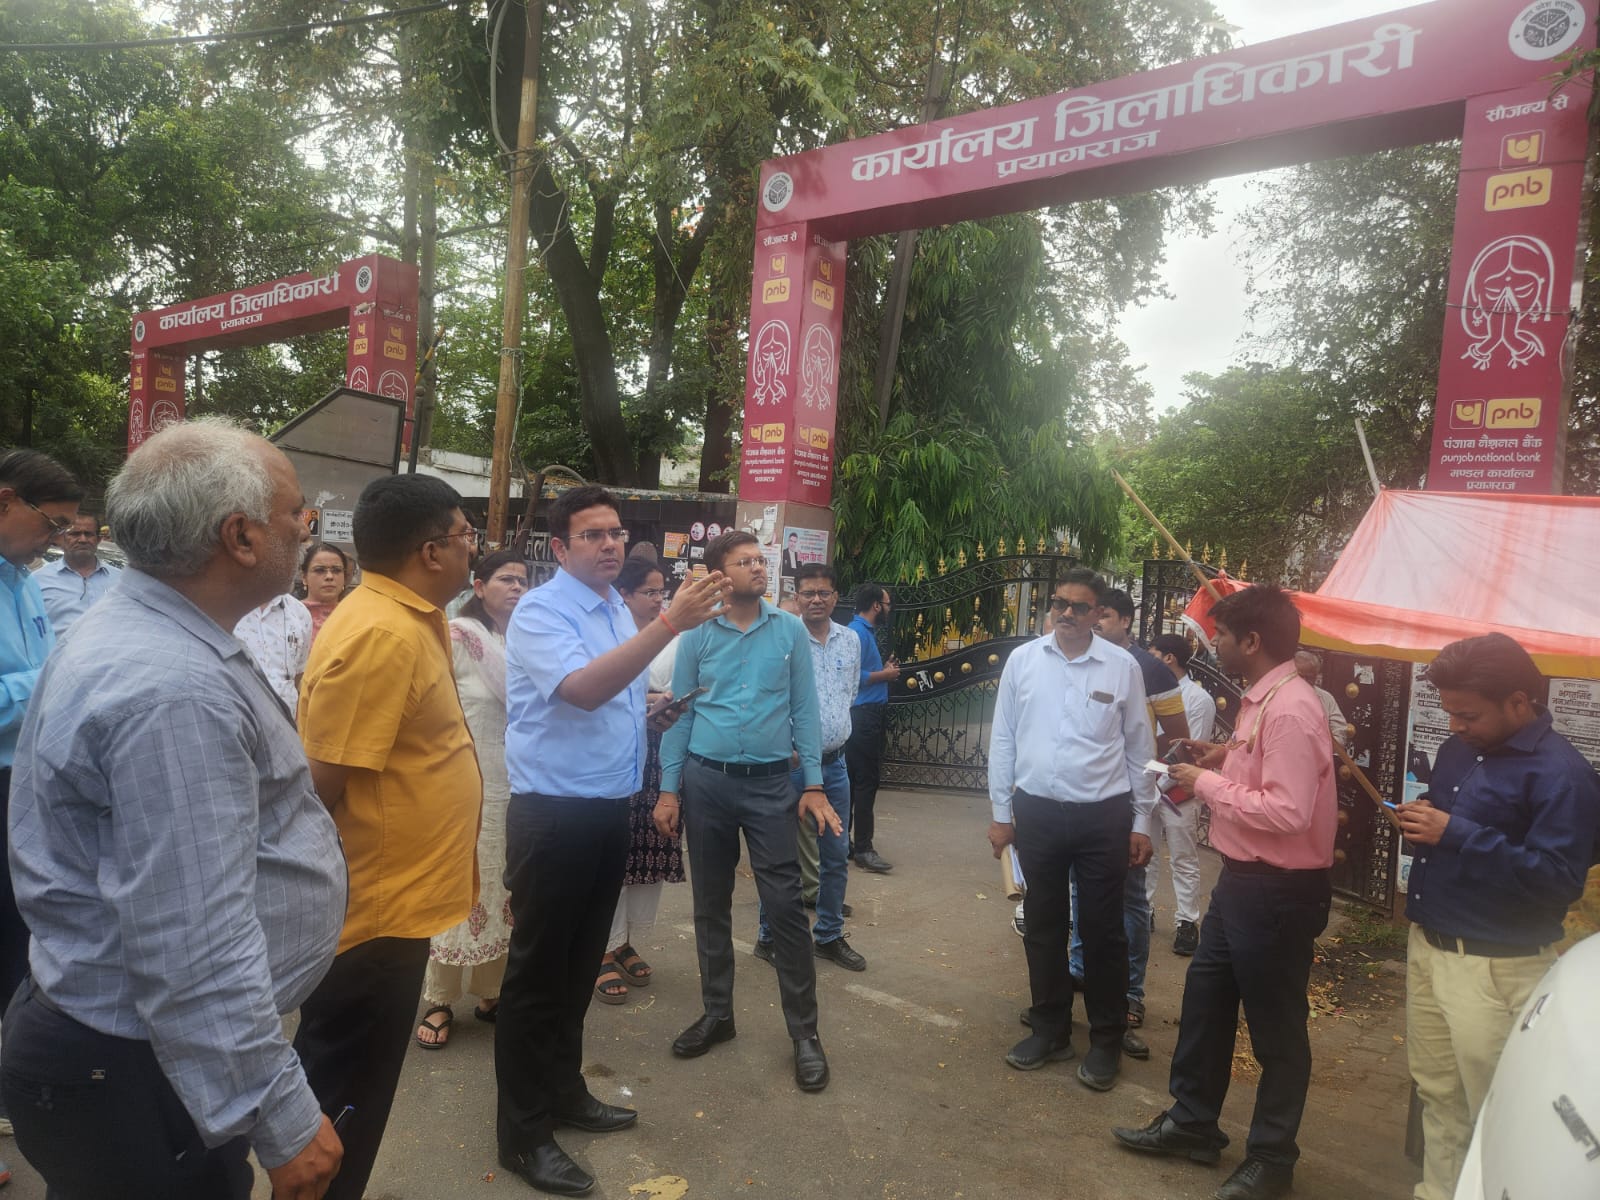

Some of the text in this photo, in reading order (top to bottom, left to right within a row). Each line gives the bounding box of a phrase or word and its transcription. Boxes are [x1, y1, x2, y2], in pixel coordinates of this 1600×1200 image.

[851, 23, 1422, 183] कार्यालय जिलाधिकारी
[1552, 94, 1569, 110] से
[997, 129, 1161, 179] प्रयागराज
[1492, 176, 1543, 206] pnb
[766, 281, 787, 301] pnb
[814, 287, 832, 302] pnb
[159, 302, 226, 330] कार्यालय
[220, 313, 263, 331] प्रयागराज
[1491, 402, 1534, 425] pnb
[764, 426, 782, 441] pnb
[811, 432, 827, 444] pnb
[1443, 436, 1475, 449] पंजाब
[1440, 452, 1541, 465] punjab national bank
[1487, 467, 1535, 478] कार्यालय
[1466, 481, 1516, 490] प्रयागराज
